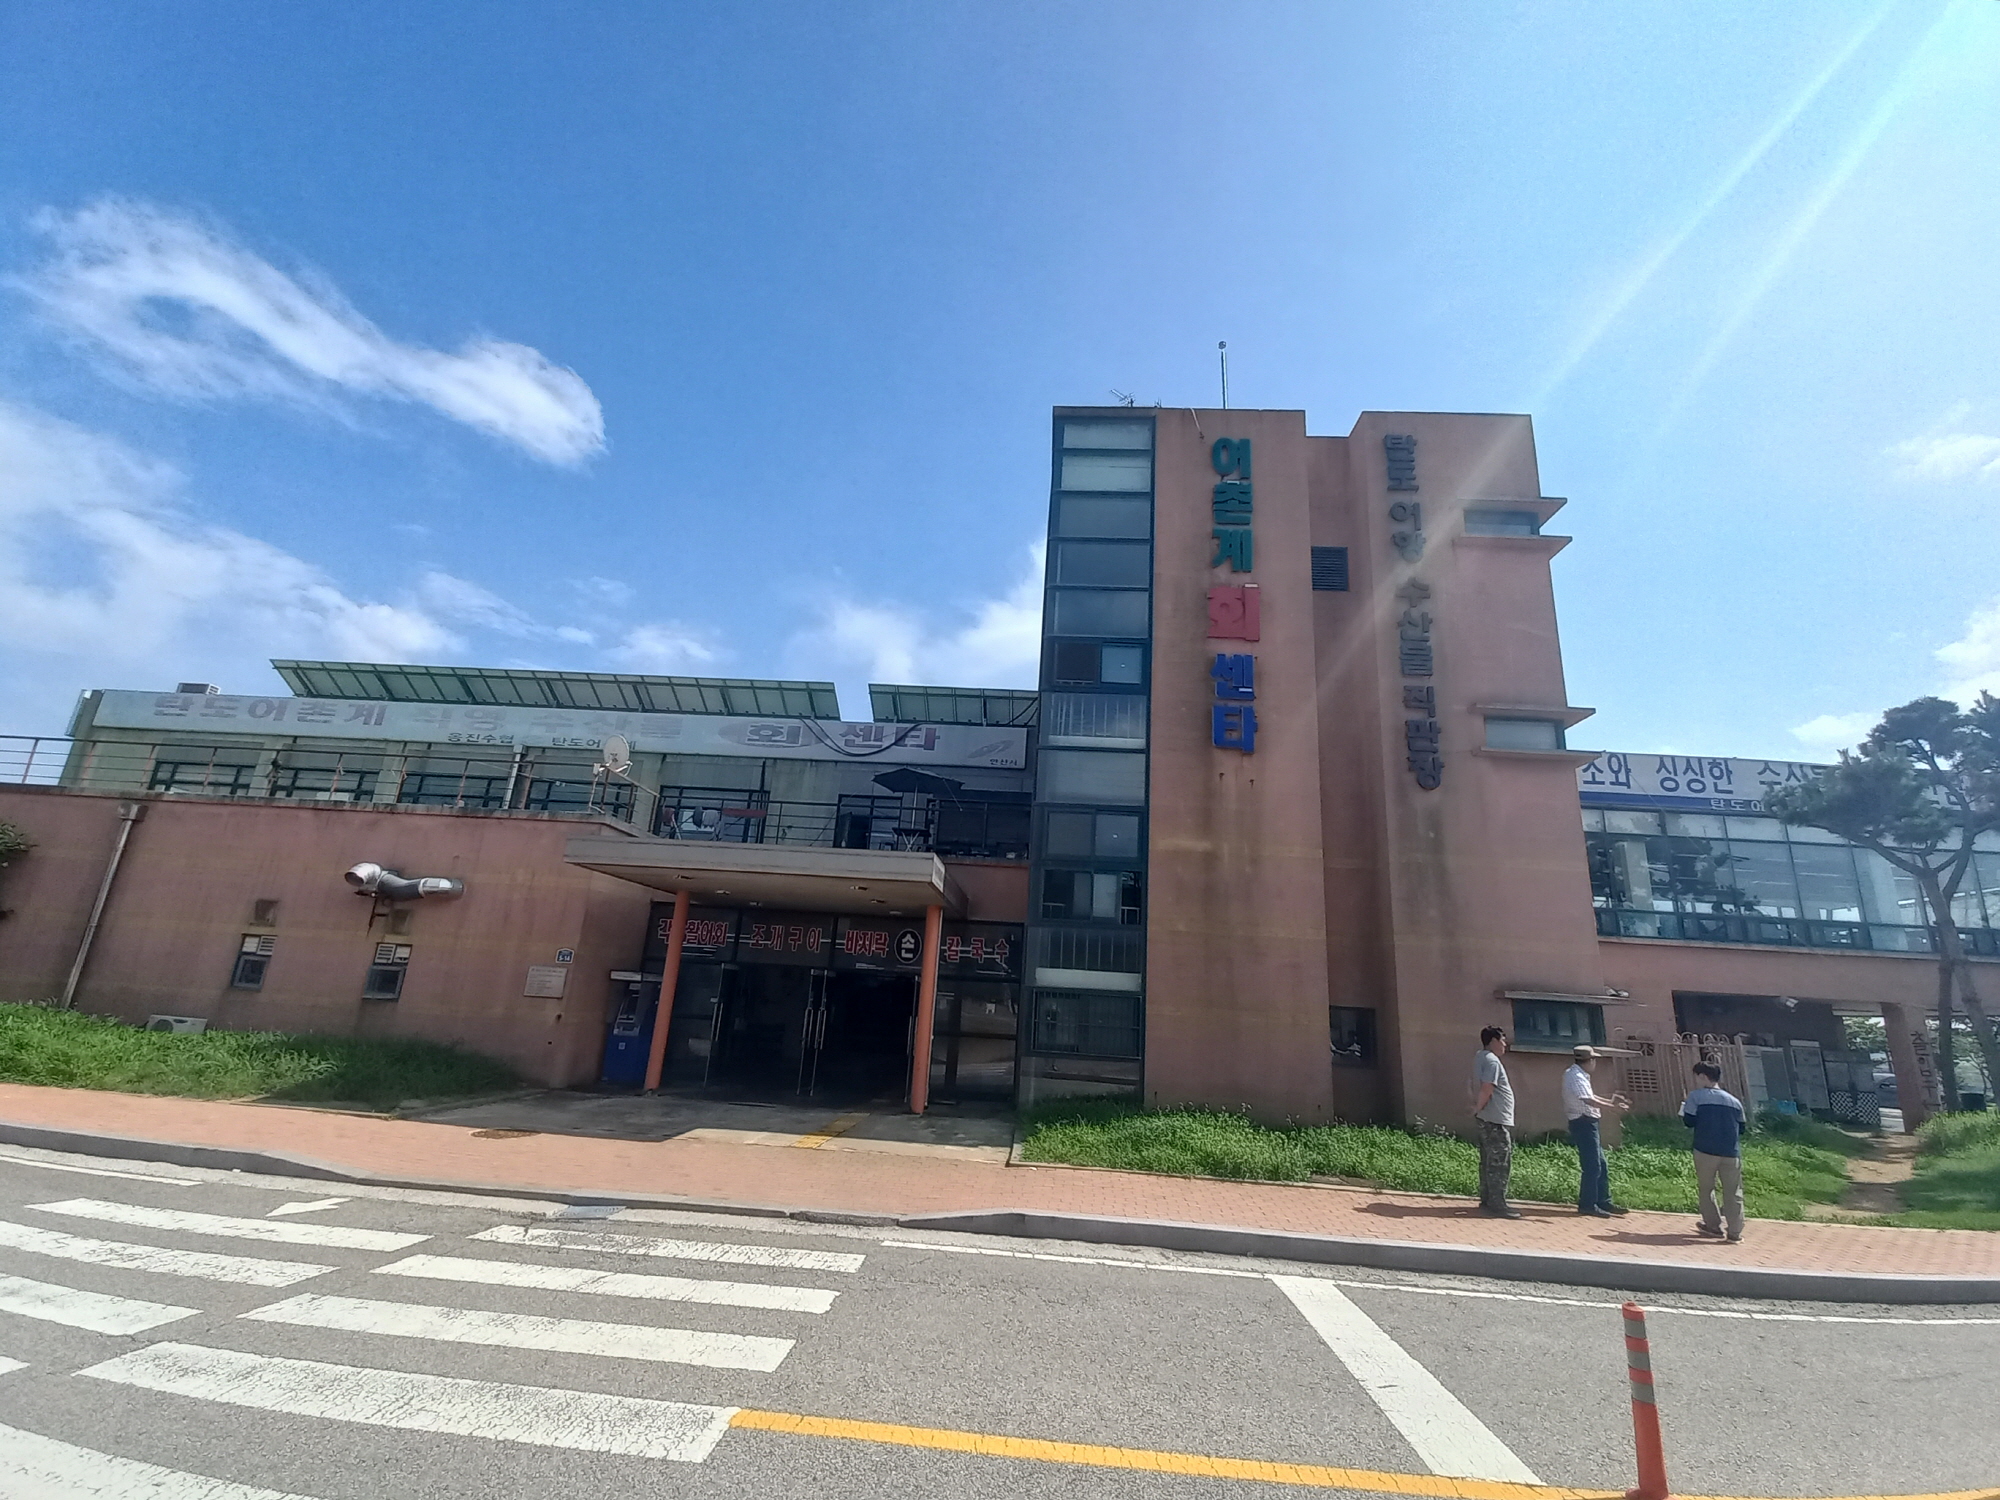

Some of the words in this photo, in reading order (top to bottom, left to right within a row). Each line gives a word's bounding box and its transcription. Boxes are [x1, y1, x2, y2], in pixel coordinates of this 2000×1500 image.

[1211, 437, 1253, 573] 어촌계
[1206, 582, 1261, 642] 회
[1395, 576, 1433, 678] 수산물
[153, 695, 388, 726] 탄도어촌계
[745, 722, 802, 746] 회
[839, 723, 941, 751] 센타
[1209, 653, 1259, 755] 센타
[1403, 685, 1445, 790] 직판장
[1656, 756, 1735, 795] 싱싱한
[657, 918, 730, 948] 각활어회
[750, 923, 823, 954] 조개구이
[844, 929, 890, 958] 바지락
[946, 936, 1010, 964] 칼국수
